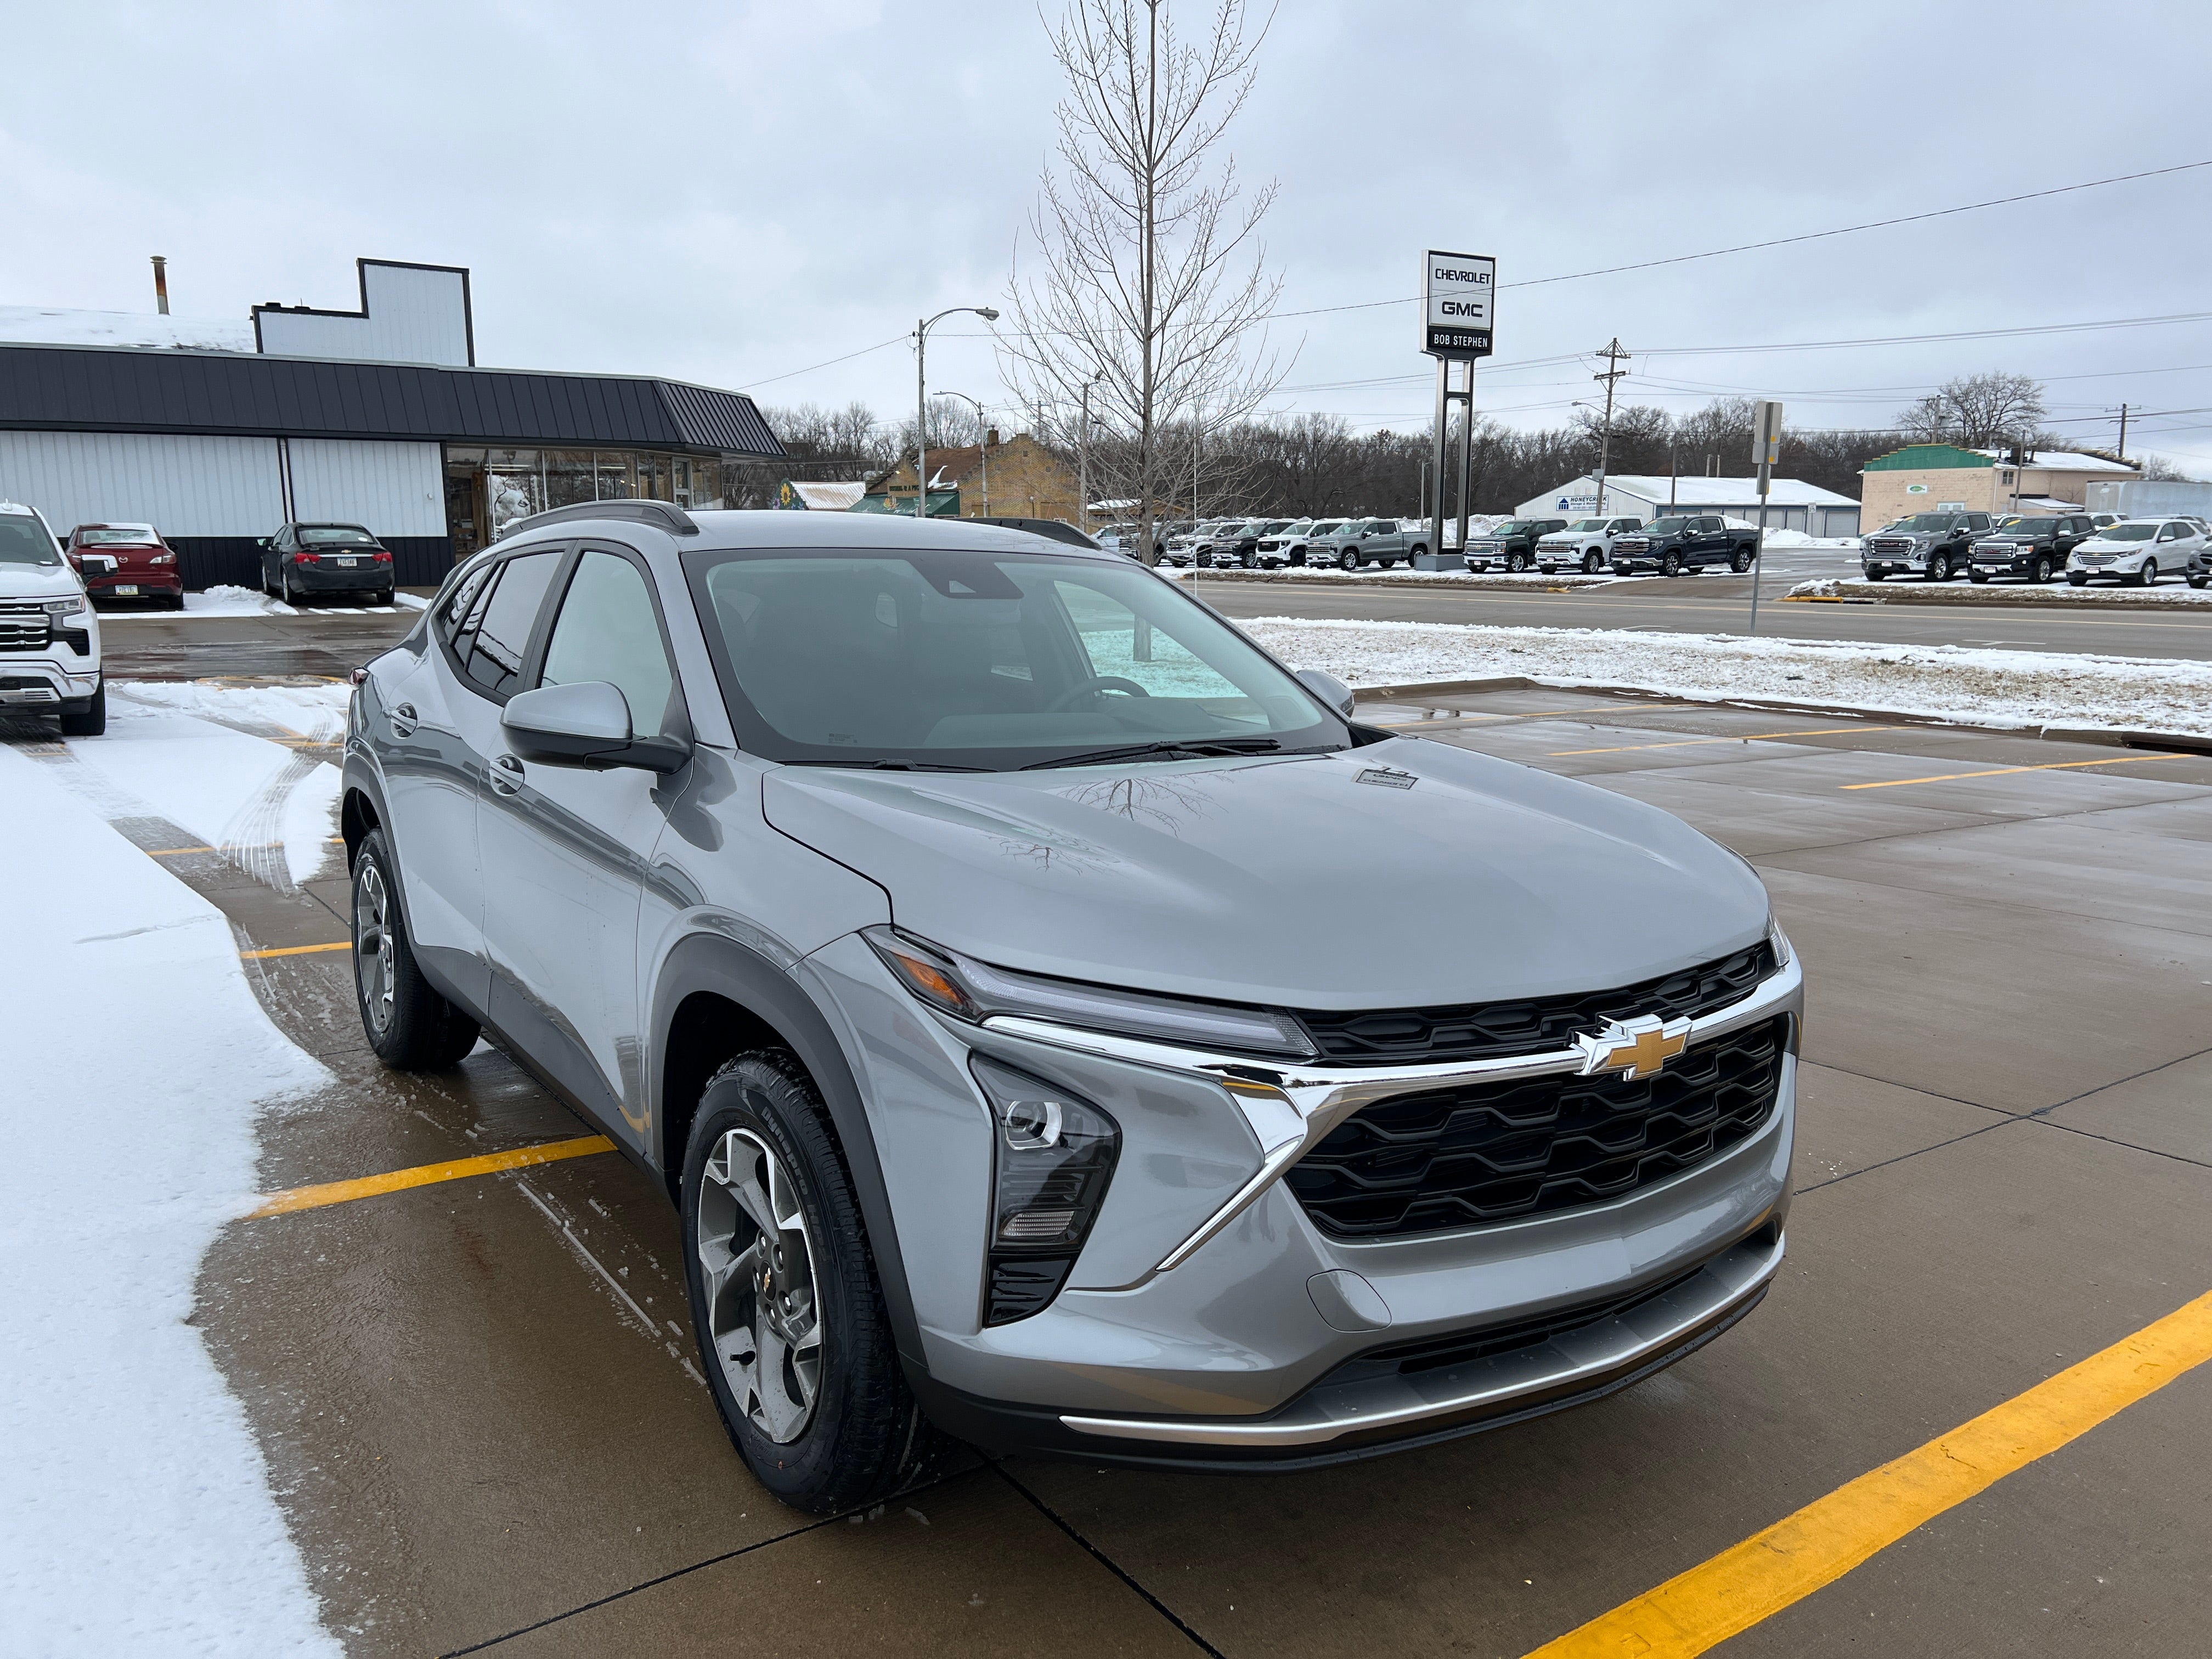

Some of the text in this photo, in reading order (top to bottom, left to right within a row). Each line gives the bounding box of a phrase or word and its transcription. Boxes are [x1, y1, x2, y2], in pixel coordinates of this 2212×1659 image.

[1435, 268, 1491, 284] CHEVROLET
[1442, 301, 1483, 318] GMC
[1434, 334, 1488, 348] BOB STEPHEN
[761, 1105, 809, 1196] Dynapro
